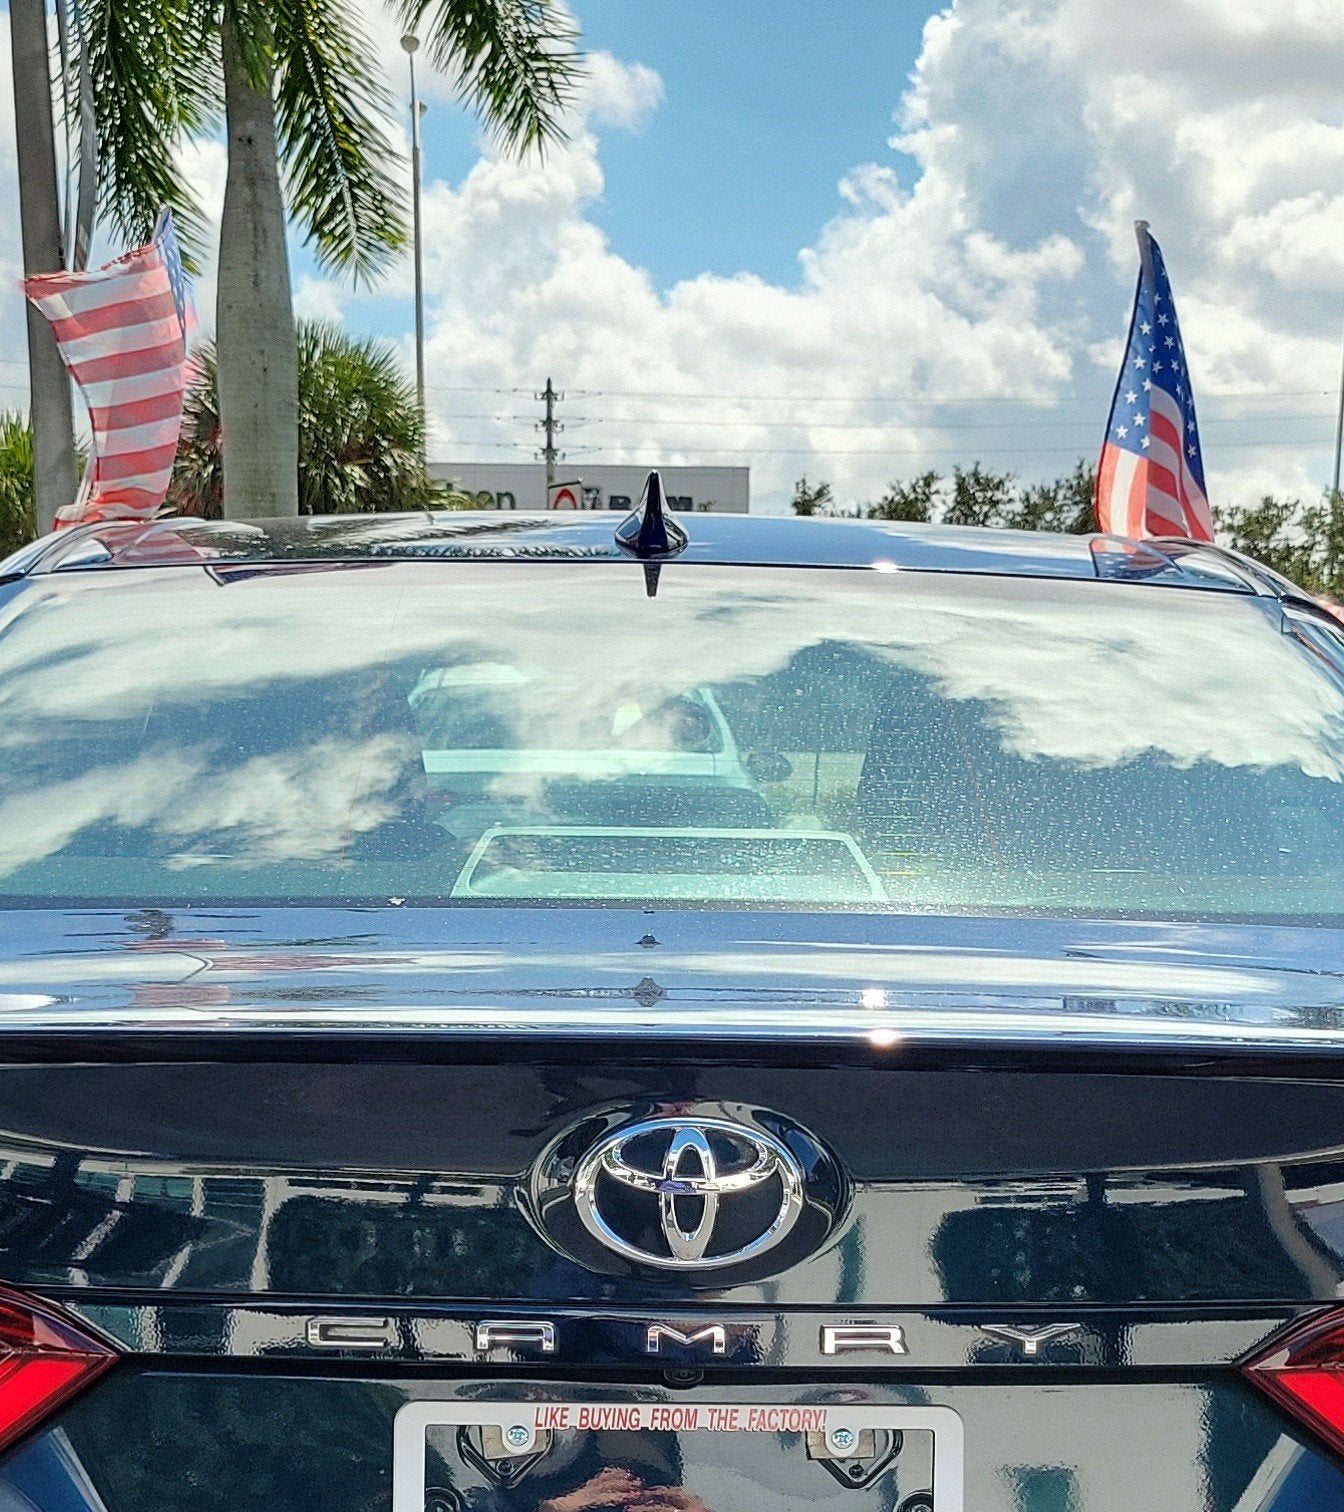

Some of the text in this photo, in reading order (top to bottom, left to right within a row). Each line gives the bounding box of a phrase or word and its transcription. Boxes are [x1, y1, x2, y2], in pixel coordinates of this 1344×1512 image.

[306, 1316, 1081, 1355] CAMRY
[534, 1406, 828, 1431] LIKE BUYING FROM THE FACTORY!
